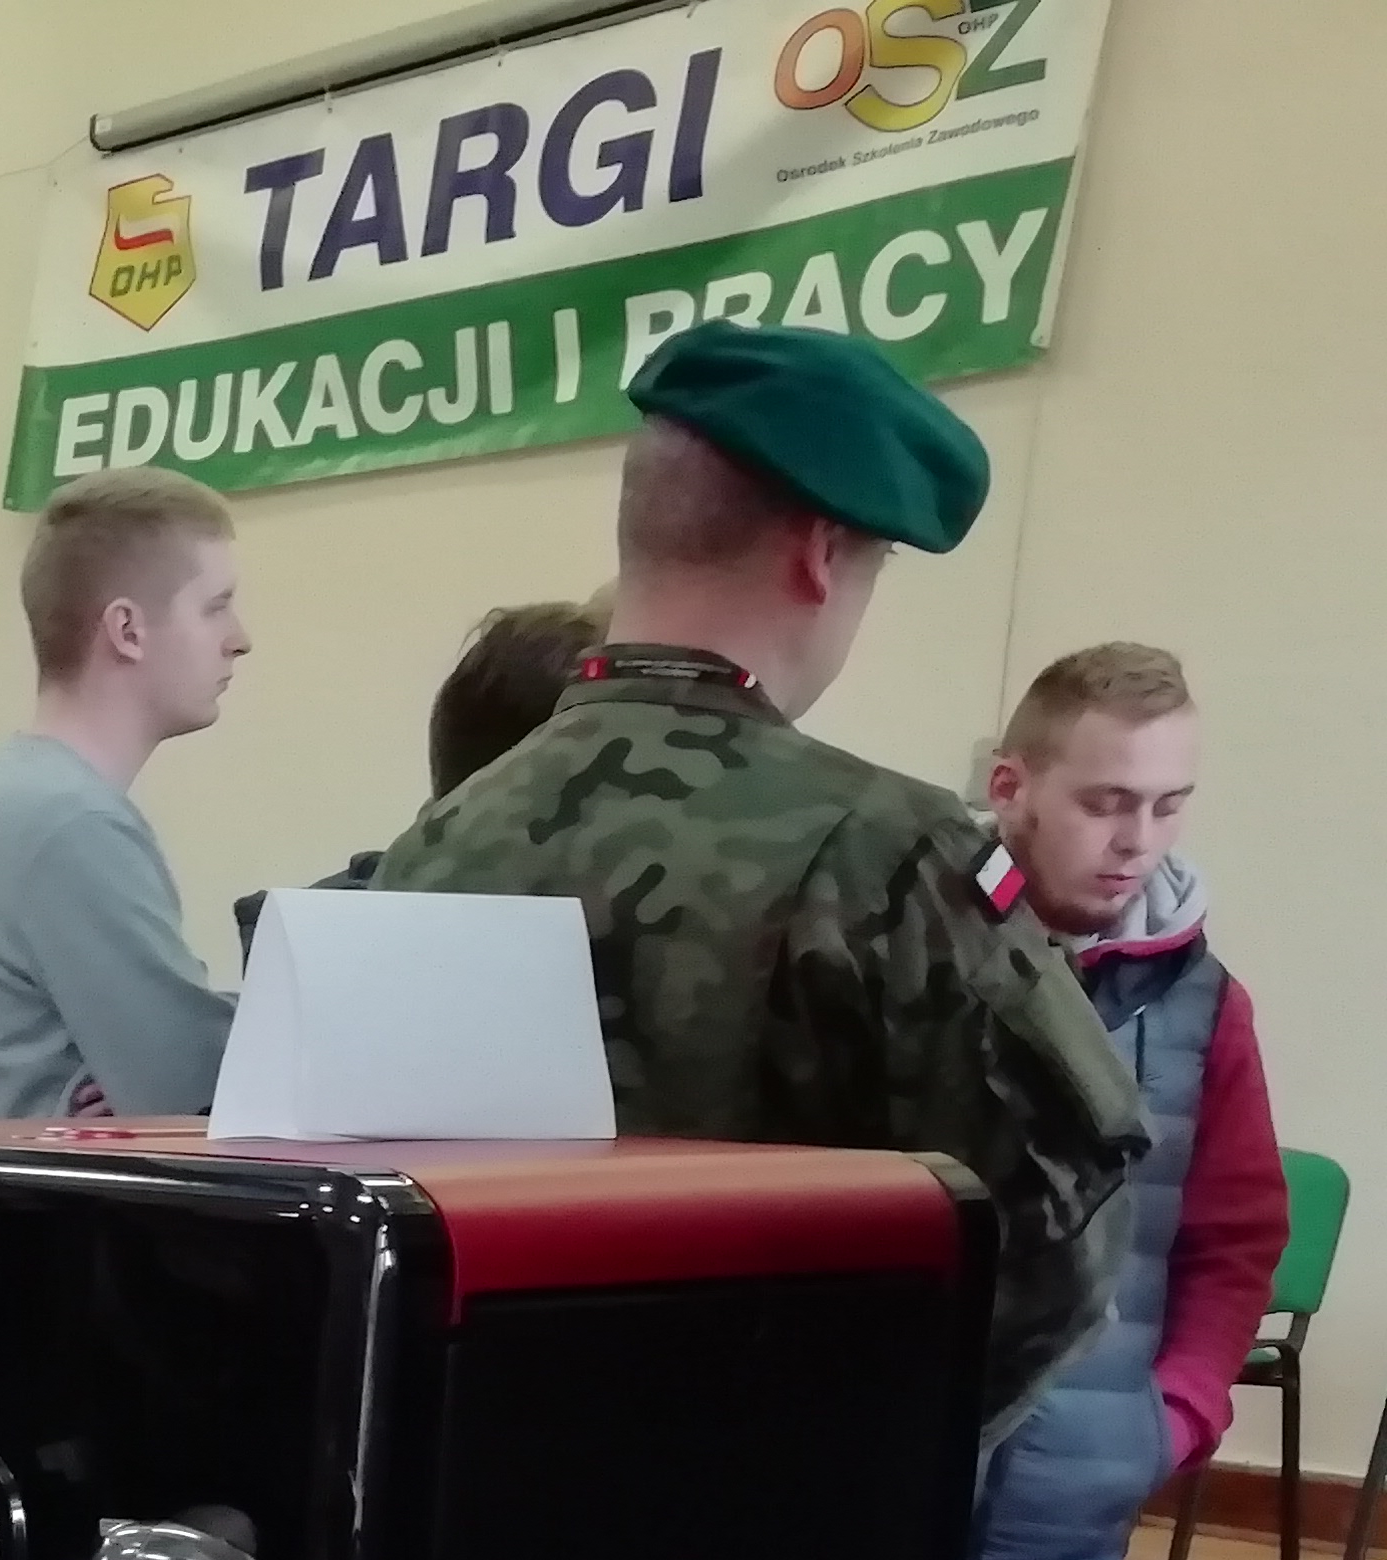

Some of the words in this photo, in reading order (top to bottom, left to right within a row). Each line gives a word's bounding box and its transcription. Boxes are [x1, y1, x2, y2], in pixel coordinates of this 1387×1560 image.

[958, 13, 998, 35] OHP
[852, 135, 924, 166] Szkolenia
[927, 108, 1040, 144] Zawodowego
[244, 47, 722, 292] TARGI
[110, 253, 183, 299] OHP
[53, 320, 513, 477] EDUKACJI
[554, 308, 580, 403] I
